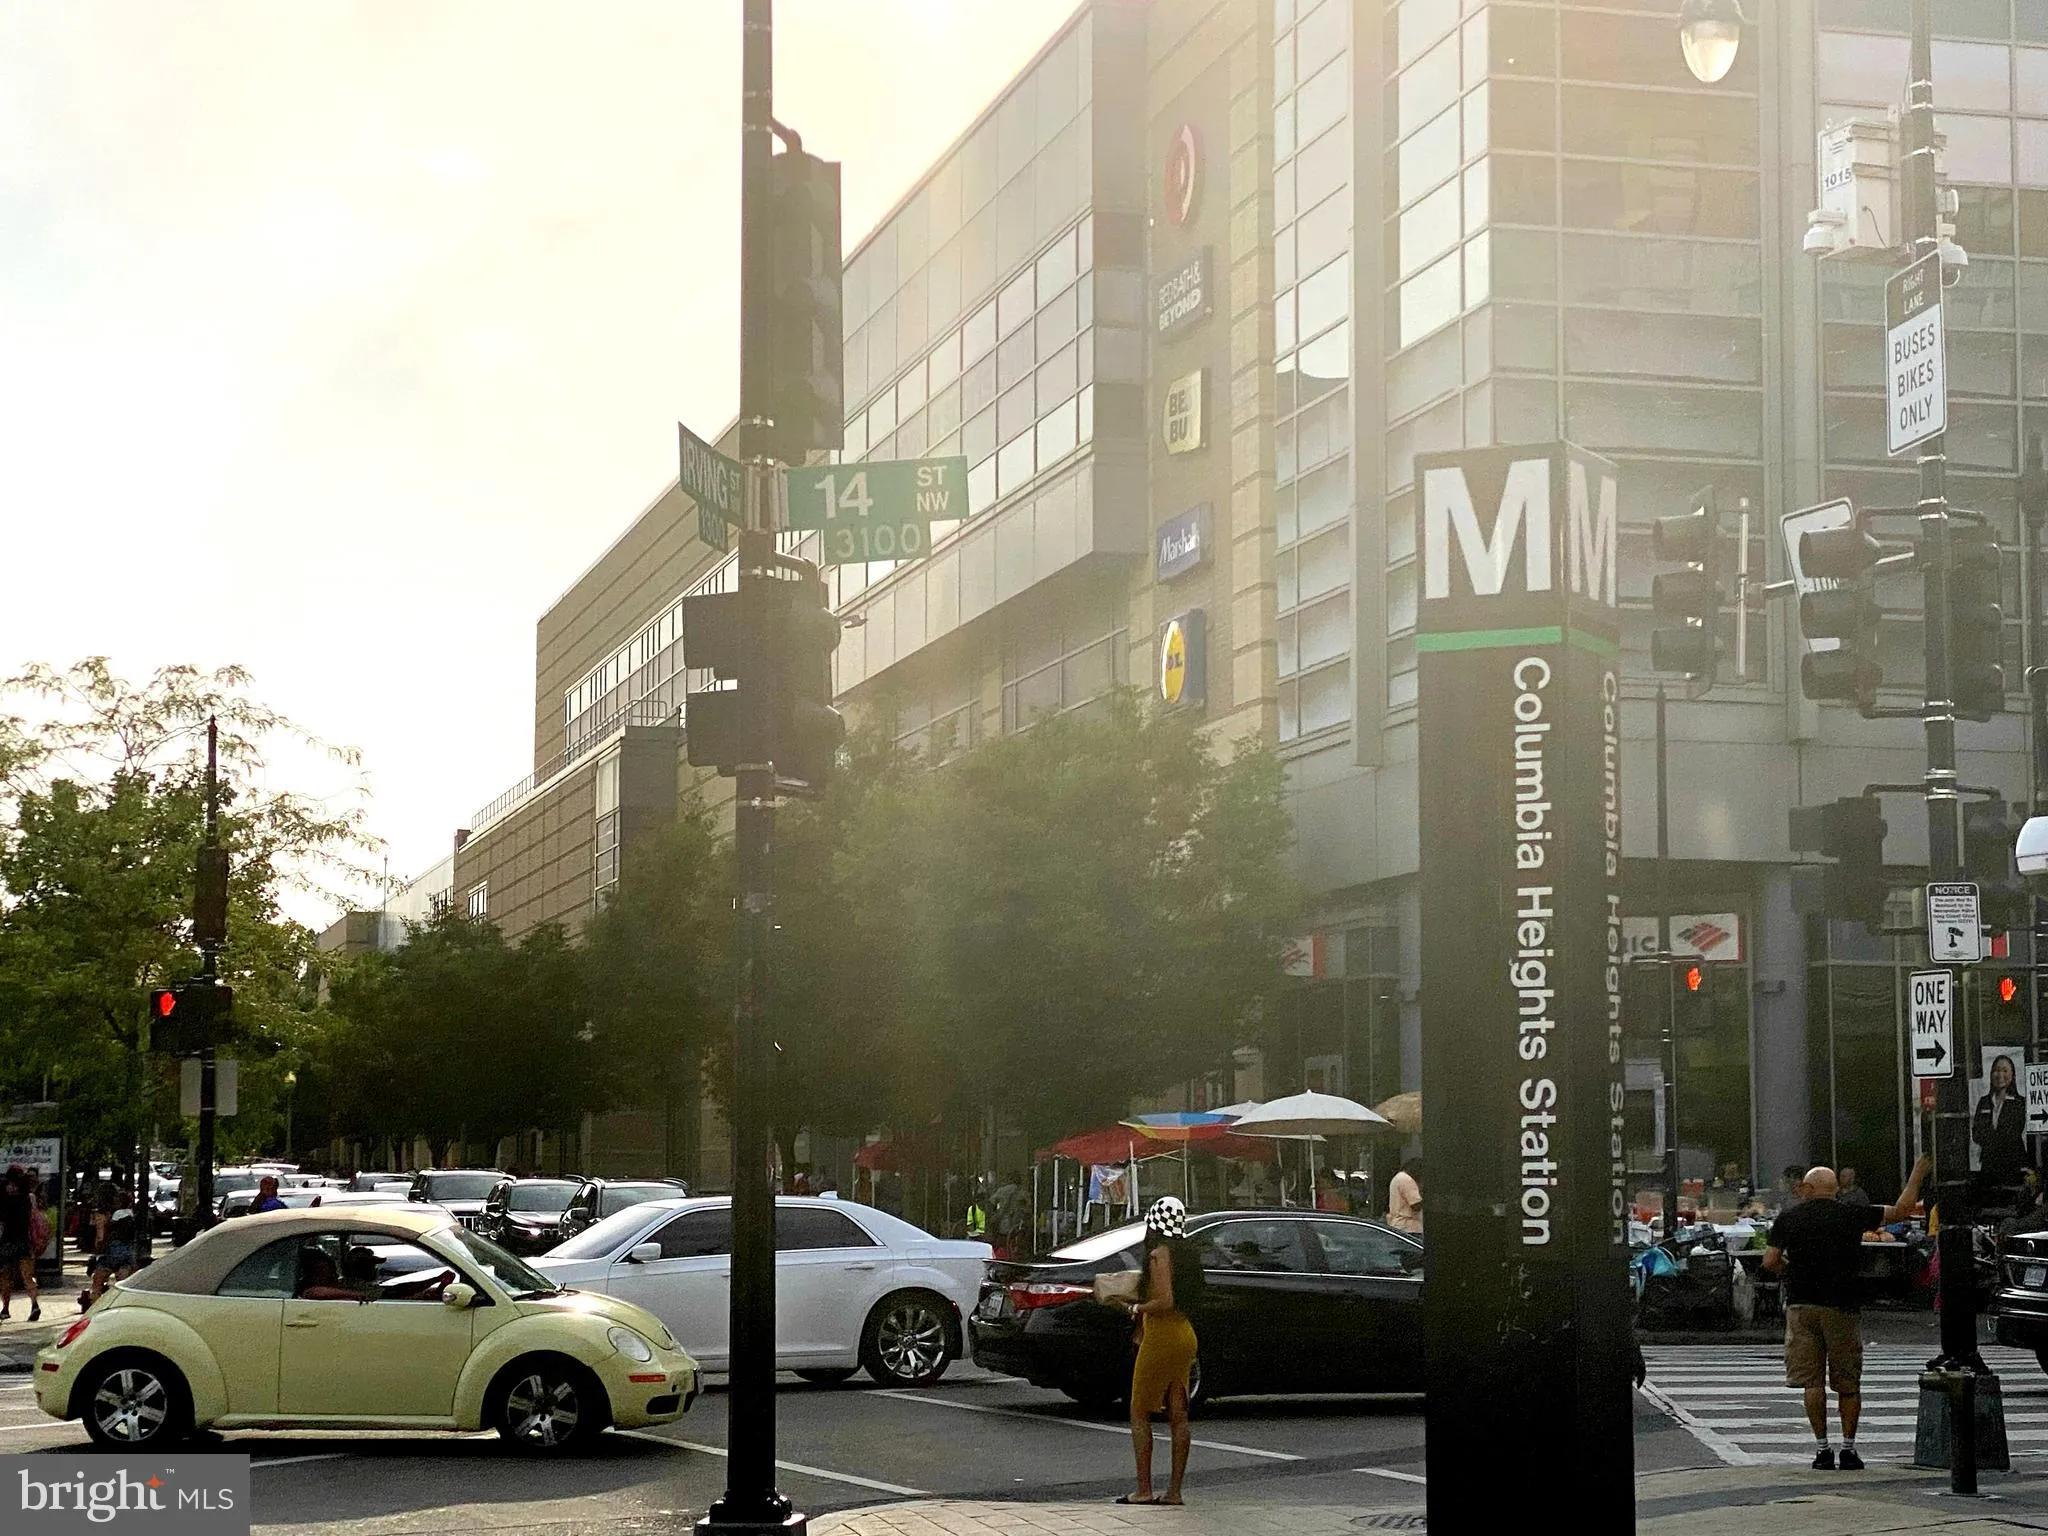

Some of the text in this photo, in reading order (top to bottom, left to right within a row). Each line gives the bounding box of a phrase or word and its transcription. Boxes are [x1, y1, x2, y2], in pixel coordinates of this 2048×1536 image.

[1824, 167, 1852, 187] 1015
[1903, 268, 1924, 294] RIGHT
[1904, 291, 1924, 314] LANE
[1894, 323, 1935, 365] BUSES
[1898, 358, 1934, 398] BIKES
[1900, 393, 1933, 430] ONLY
[683, 436, 728, 509] IRVING
[729, 468, 741, 491] ST
[916, 465, 947, 487] ST
[814, 471, 873, 519] 14
[916, 490, 949, 512] NW
[836, 523, 920, 558] 3100
[1424, 458, 1551, 600] M
[1569, 460, 1616, 607] M
[1935, 886, 1971, 895] NOTICE
[1510, 657, 1557, 1246] Columbia Heights Station
[1603, 671, 1625, 1245] Columbia Heights Station
[1915, 980, 1946, 1006] ONE
[1916, 1009, 1947, 1034] WAY
[2029, 1071, 2048, 1088] ONE
